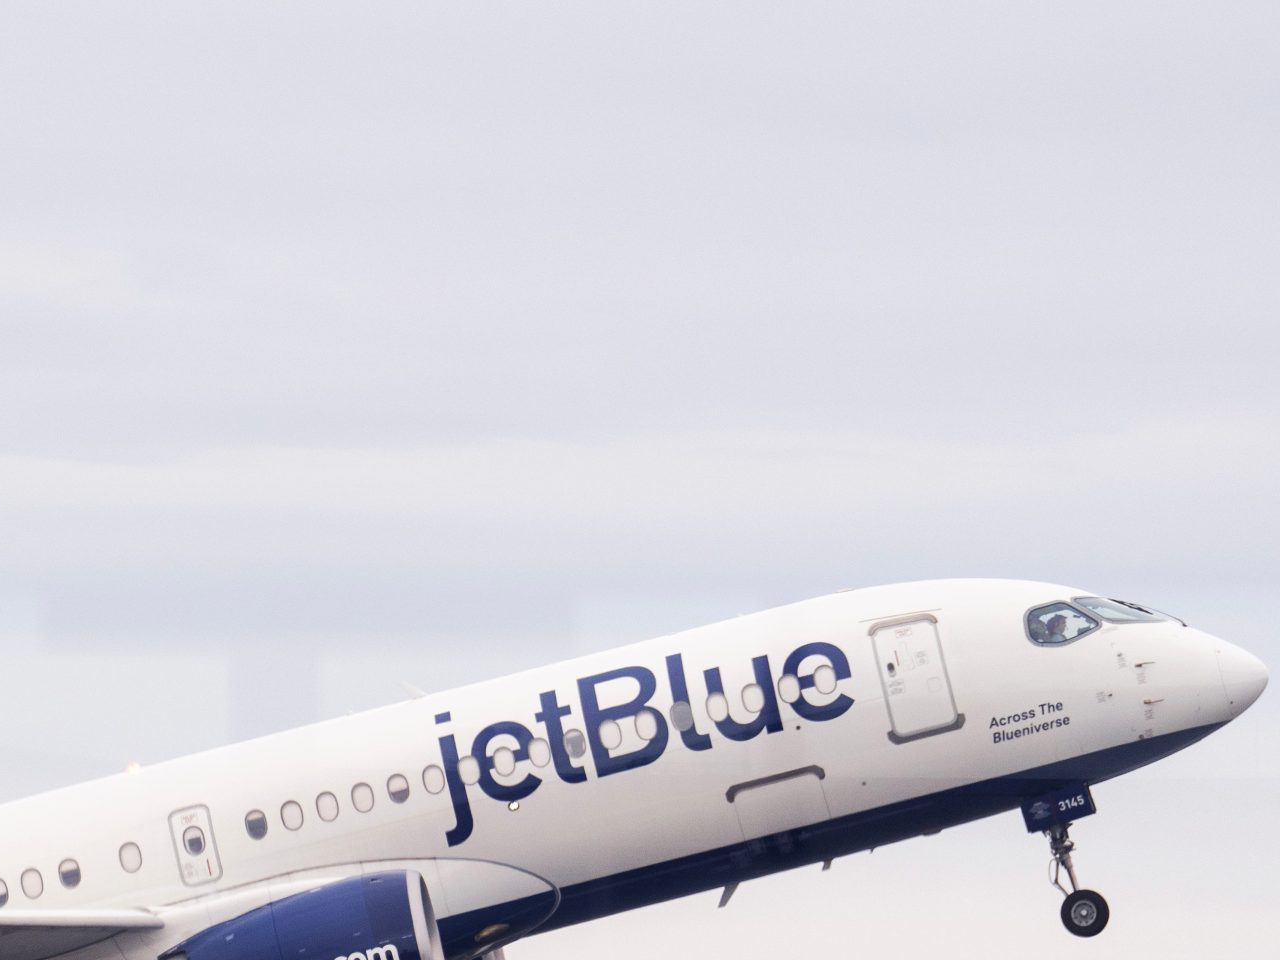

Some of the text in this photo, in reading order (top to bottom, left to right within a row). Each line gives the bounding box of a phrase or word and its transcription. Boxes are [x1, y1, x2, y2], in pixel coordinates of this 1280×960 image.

[989, 702, 1063, 729] Across The
[992, 716, 1070, 744] Blueniverse
[434, 641, 855, 847] jetBlue
[1058, 795, 1085, 811] 3145
